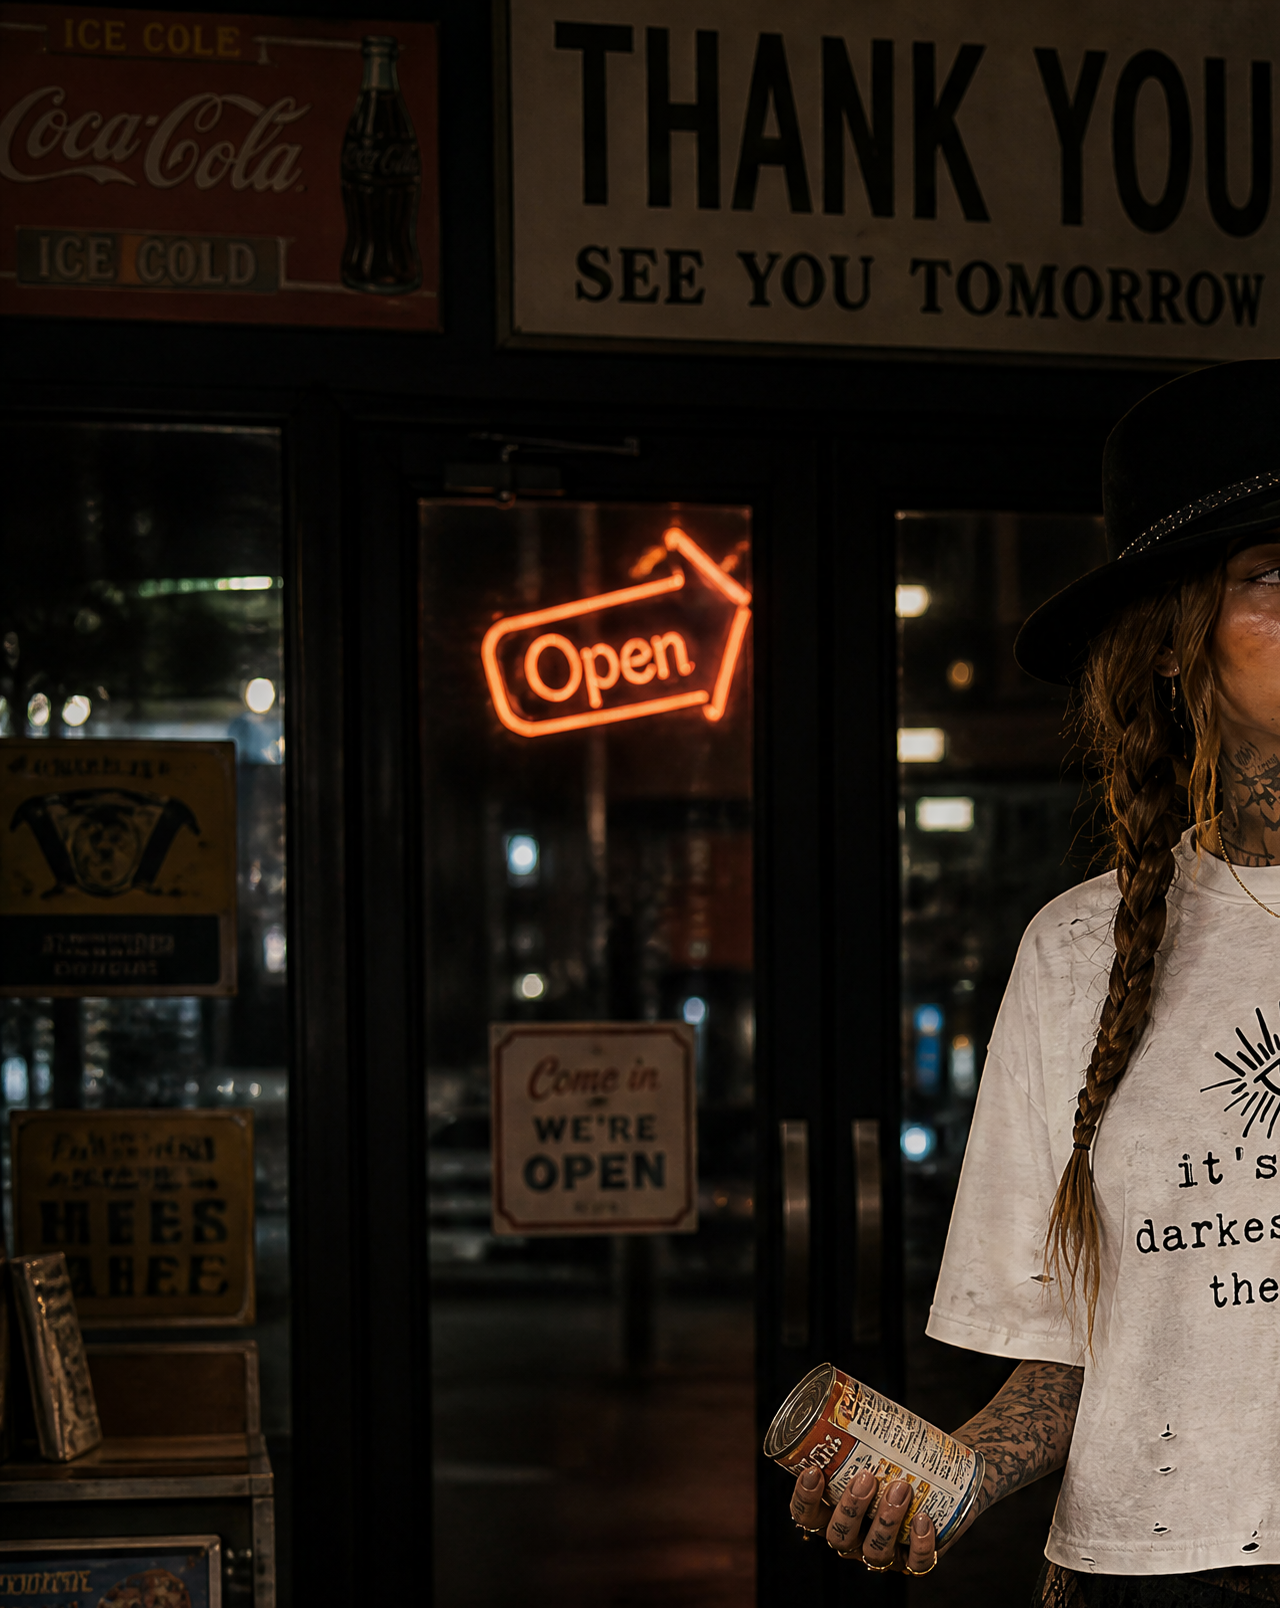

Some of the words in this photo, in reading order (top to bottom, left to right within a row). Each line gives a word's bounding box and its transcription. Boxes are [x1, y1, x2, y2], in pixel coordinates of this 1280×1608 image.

[64, 19, 126, 52] ICE
[143, 23, 241, 57] COLE
[555, 22, 990, 223] THANK
[1034, 48, 1273, 237] YOU
[38, 235, 117, 281] ICE
[137, 237, 258, 287] COLD
[576, 246, 705, 305] SEE
[737, 251, 874, 310] YOU
[911, 258, 1265, 327] TOMORROW
[523, 630, 695, 709] Open
[528, 1057, 620, 1101] Come
[627, 1059, 661, 1094] in
[534, 1114, 657, 1143] WE'RE
[523, 1152, 666, 1191] OPEN
[1178, 1146, 1278, 1188] it's
[1210, 1273, 1279, 1308] the
